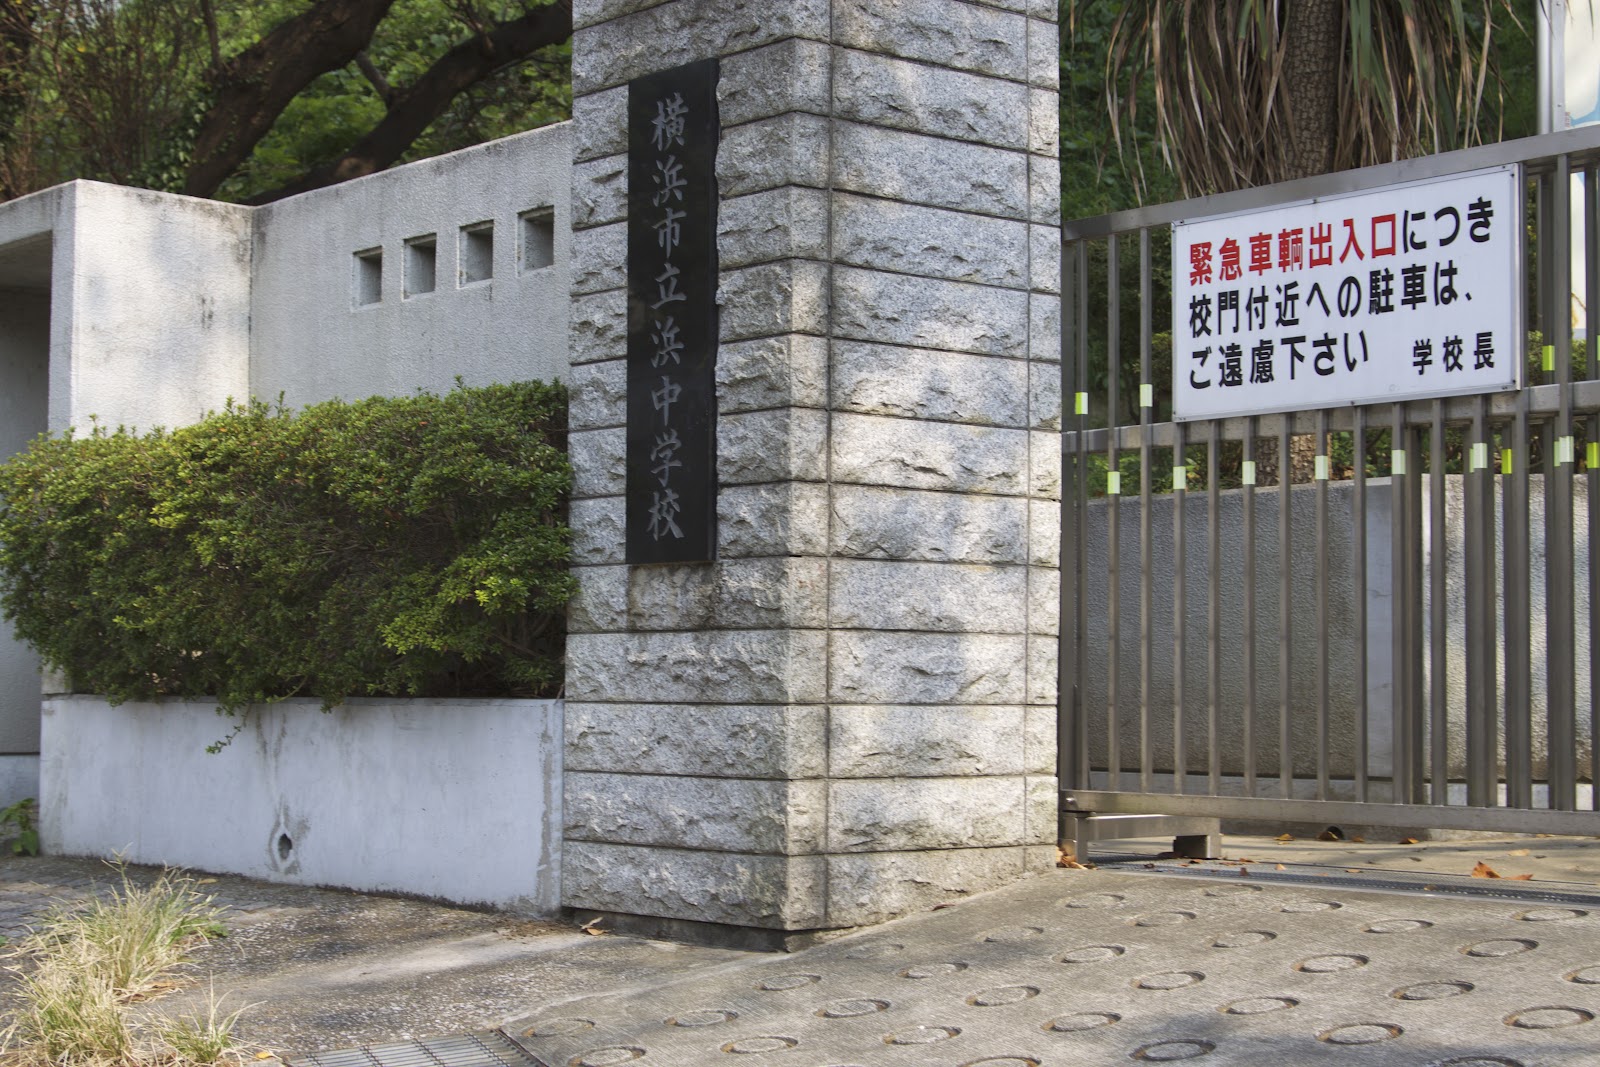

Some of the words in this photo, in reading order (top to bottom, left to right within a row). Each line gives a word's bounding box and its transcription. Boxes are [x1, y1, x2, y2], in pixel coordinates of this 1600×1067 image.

[1189, 197, 1494, 286] 緊急車輌出入口につき
[648, 92, 688, 541] 横浜市立浜中学校
[1189, 260, 1472, 338] 校門付近への駐車は、
[1190, 330, 1368, 390] ご遠慮下さい
[1412, 331, 1495, 376] 学校長
